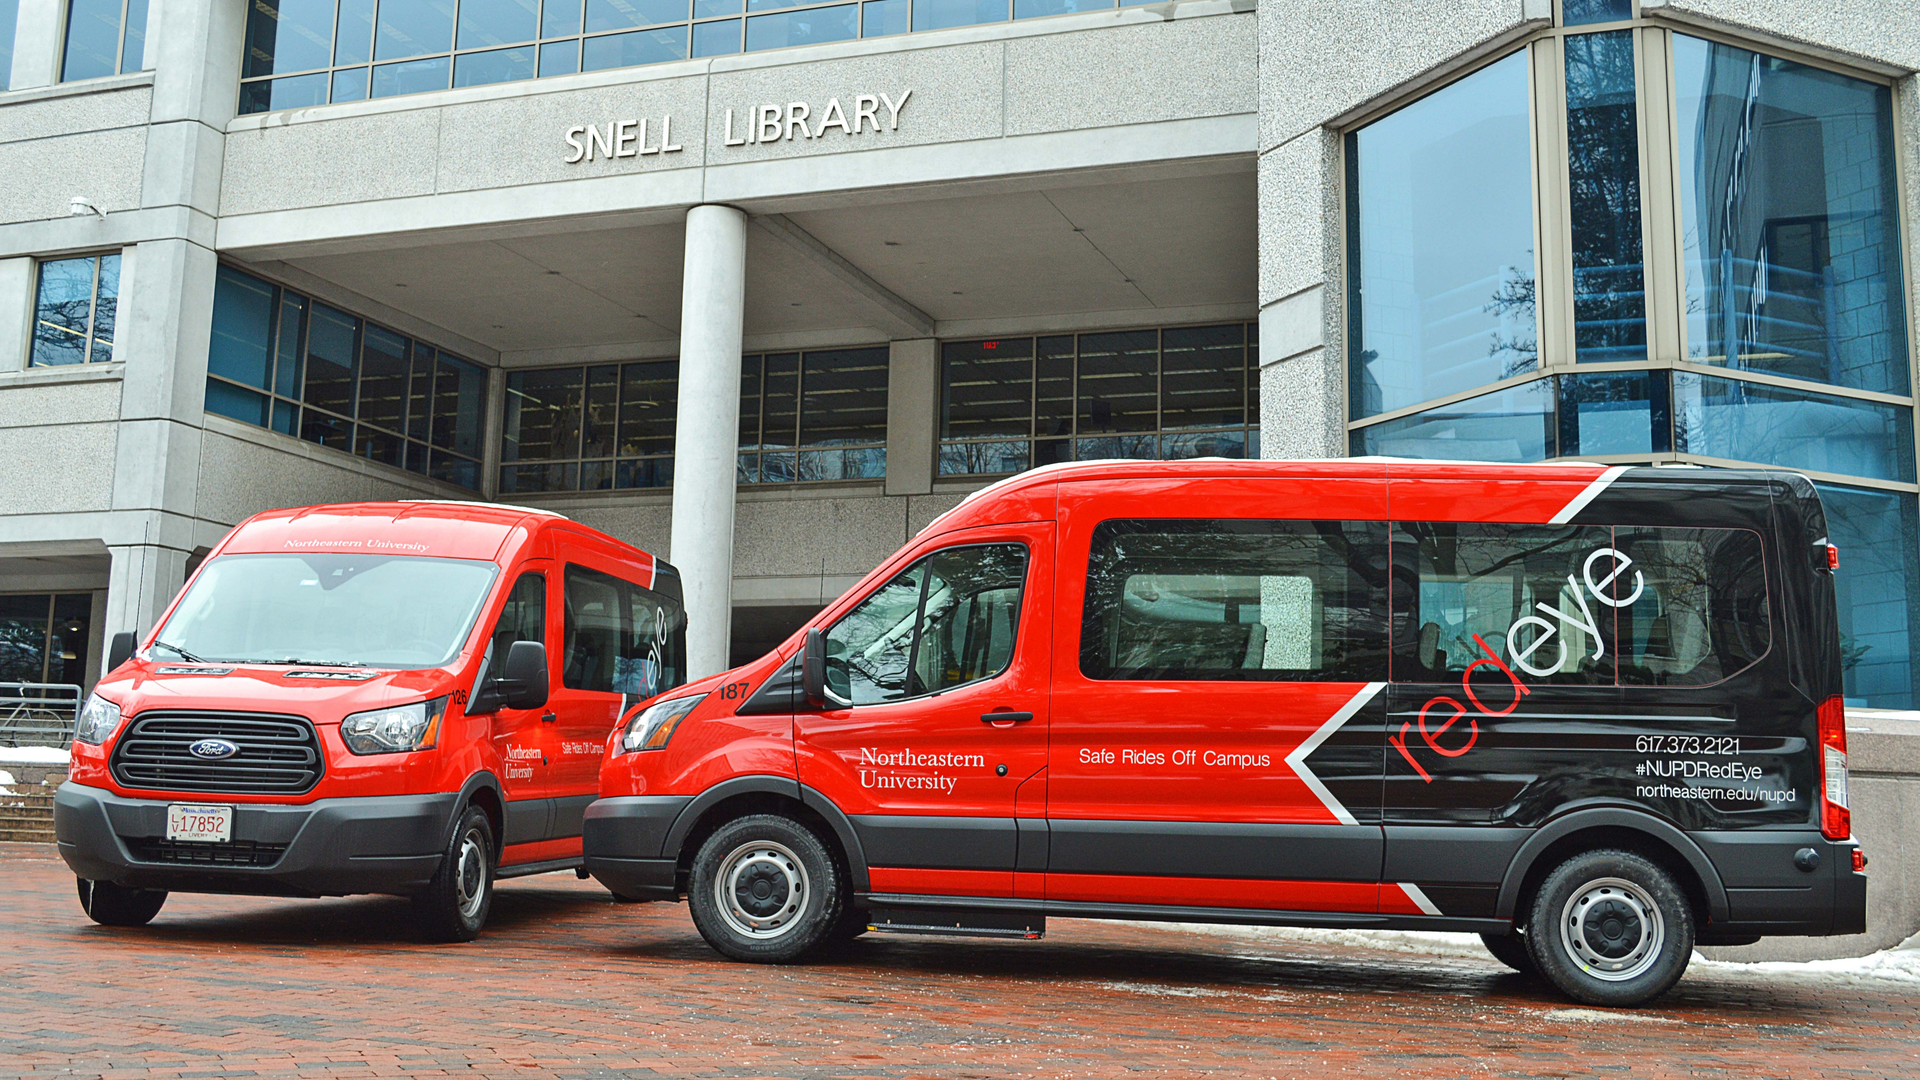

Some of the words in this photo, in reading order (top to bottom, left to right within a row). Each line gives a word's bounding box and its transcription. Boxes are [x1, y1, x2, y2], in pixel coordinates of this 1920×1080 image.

[563, 114, 683, 163] SNELL
[724, 90, 913, 147] LIBRARY
[283, 538, 362, 549] Northeastern
[366, 539, 430, 552] University
[1388, 547, 1645, 785] redeye
[451, 688, 468, 705] 126
[718, 682, 750, 700] 187
[198, 742, 224, 755] Ford
[505, 743, 542, 760] Northeastern
[561, 741, 572, 755] Safe
[572, 741, 583, 754] Rides
[590, 741, 605, 756] Campus
[1635, 735, 1740, 755] 617.373.2121
[859, 747, 985, 767] Northeastern
[1078, 748, 1116, 764] Safe
[1121, 749, 1166, 765] Rides
[1171, 749, 1197, 766] Off
[1203, 750, 1271, 769] Campus
[505, 763, 535, 783] University
[1635, 759, 1763, 782] #NUPDRedEye
[859, 770, 958, 795] University
[1635, 785, 1796, 804] northeastern.edu/nupd
[181, 815, 224, 833] 17852
